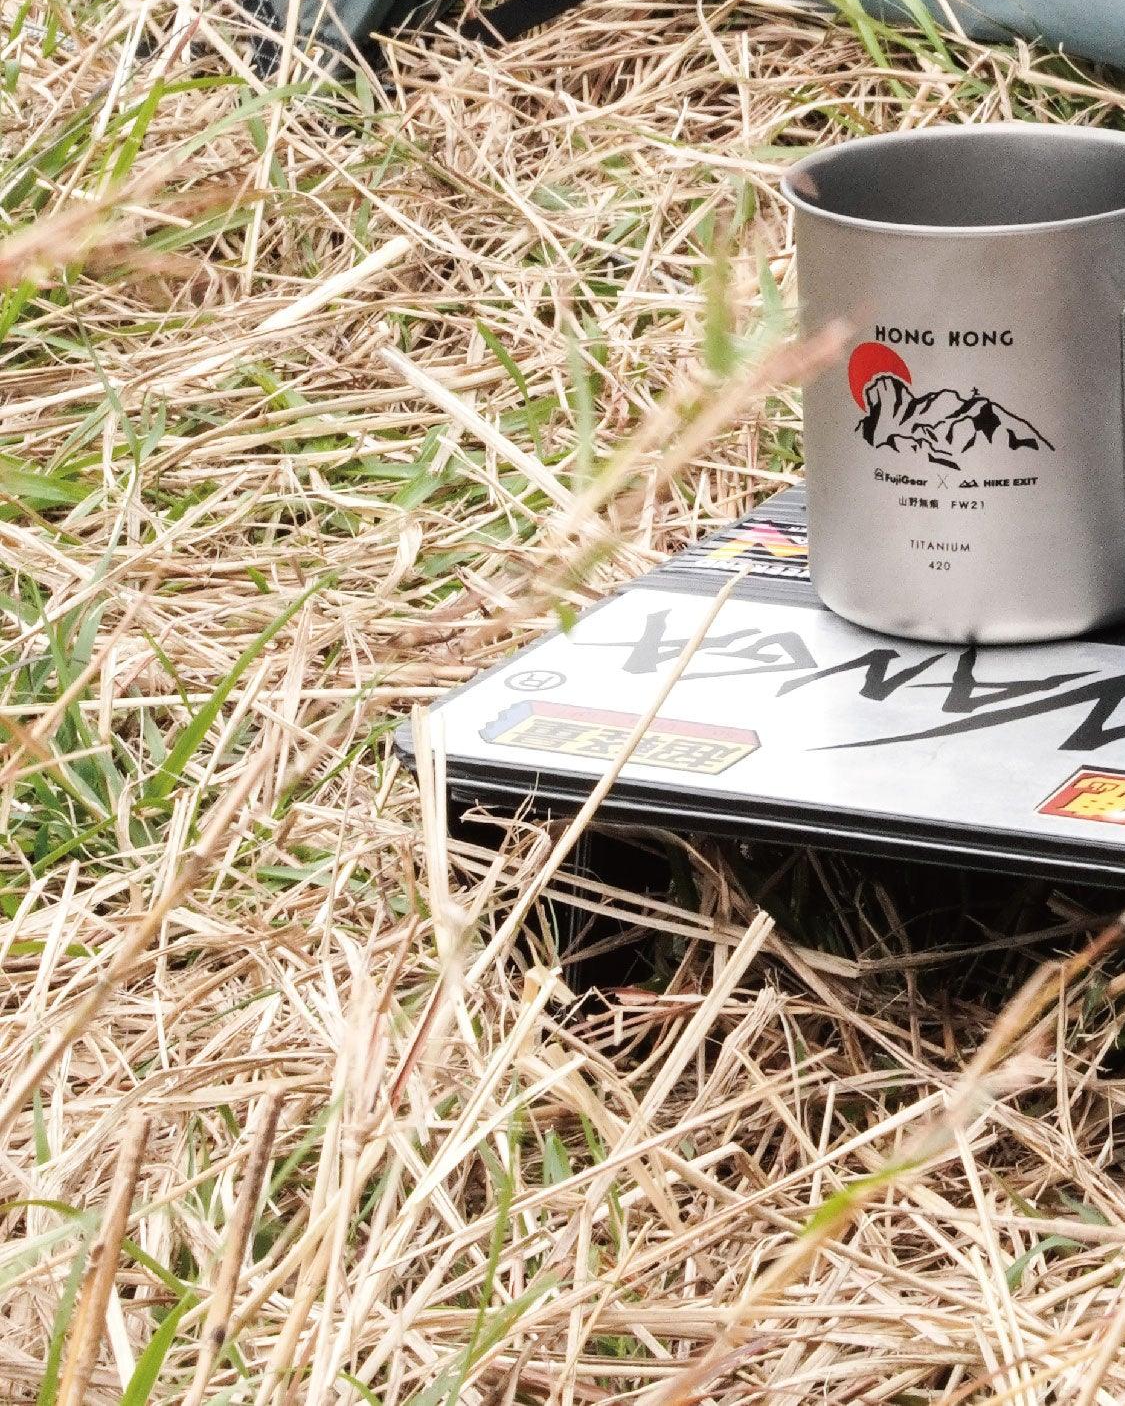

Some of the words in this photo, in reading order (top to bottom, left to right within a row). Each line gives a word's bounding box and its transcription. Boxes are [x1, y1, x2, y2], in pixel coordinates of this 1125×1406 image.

[876, 325, 935, 346] HONG
[949, 330, 1014, 346] KONG
[885, 474, 928, 487] FujiGear
[984, 479, 1010, 487] HIKE
[1013, 477, 1038, 486] EXIT
[951, 500, 985, 510] FW21
[910, 539, 970, 552] TITANIUM
[929, 561, 951, 570] 420
